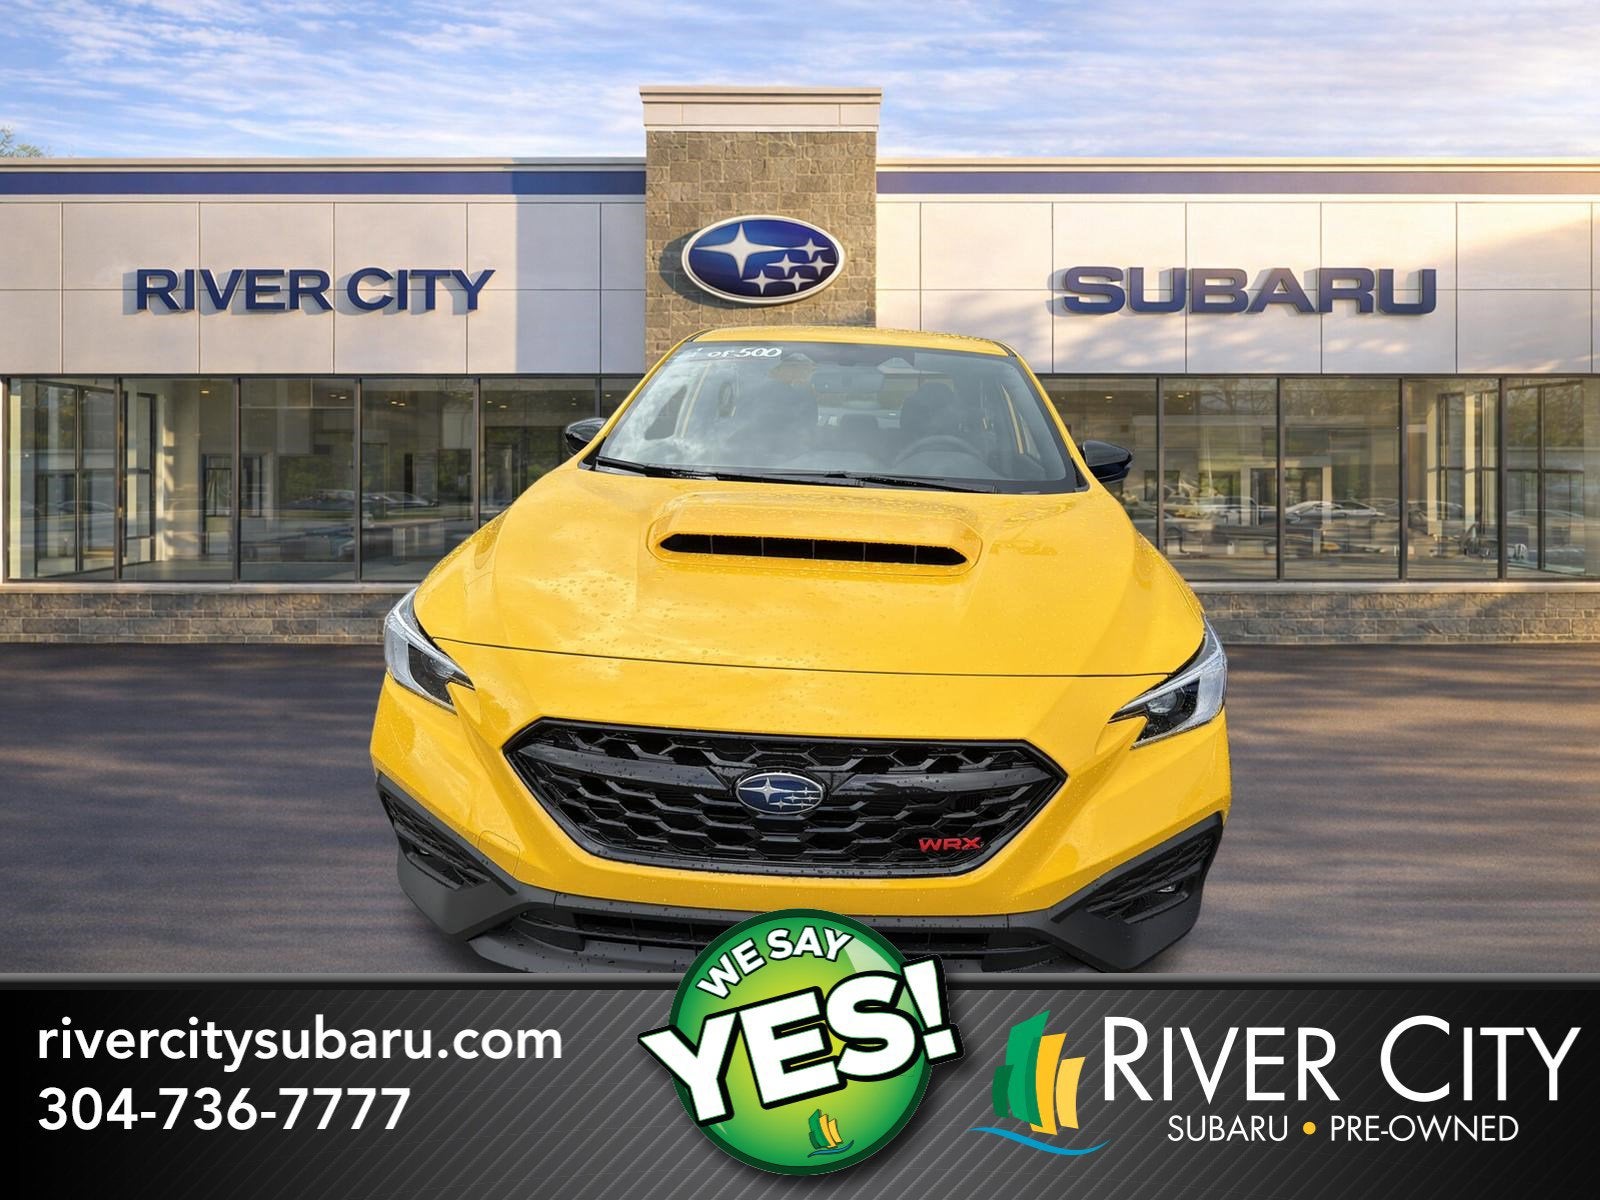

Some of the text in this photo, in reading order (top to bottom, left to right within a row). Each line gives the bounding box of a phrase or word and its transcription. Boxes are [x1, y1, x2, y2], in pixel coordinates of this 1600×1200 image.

[136, 267, 495, 311] RIVER CITY
[1063, 266, 1437, 314] SUBARU
[734, 347, 782, 358] 500
[918, 836, 981, 852] WRX
